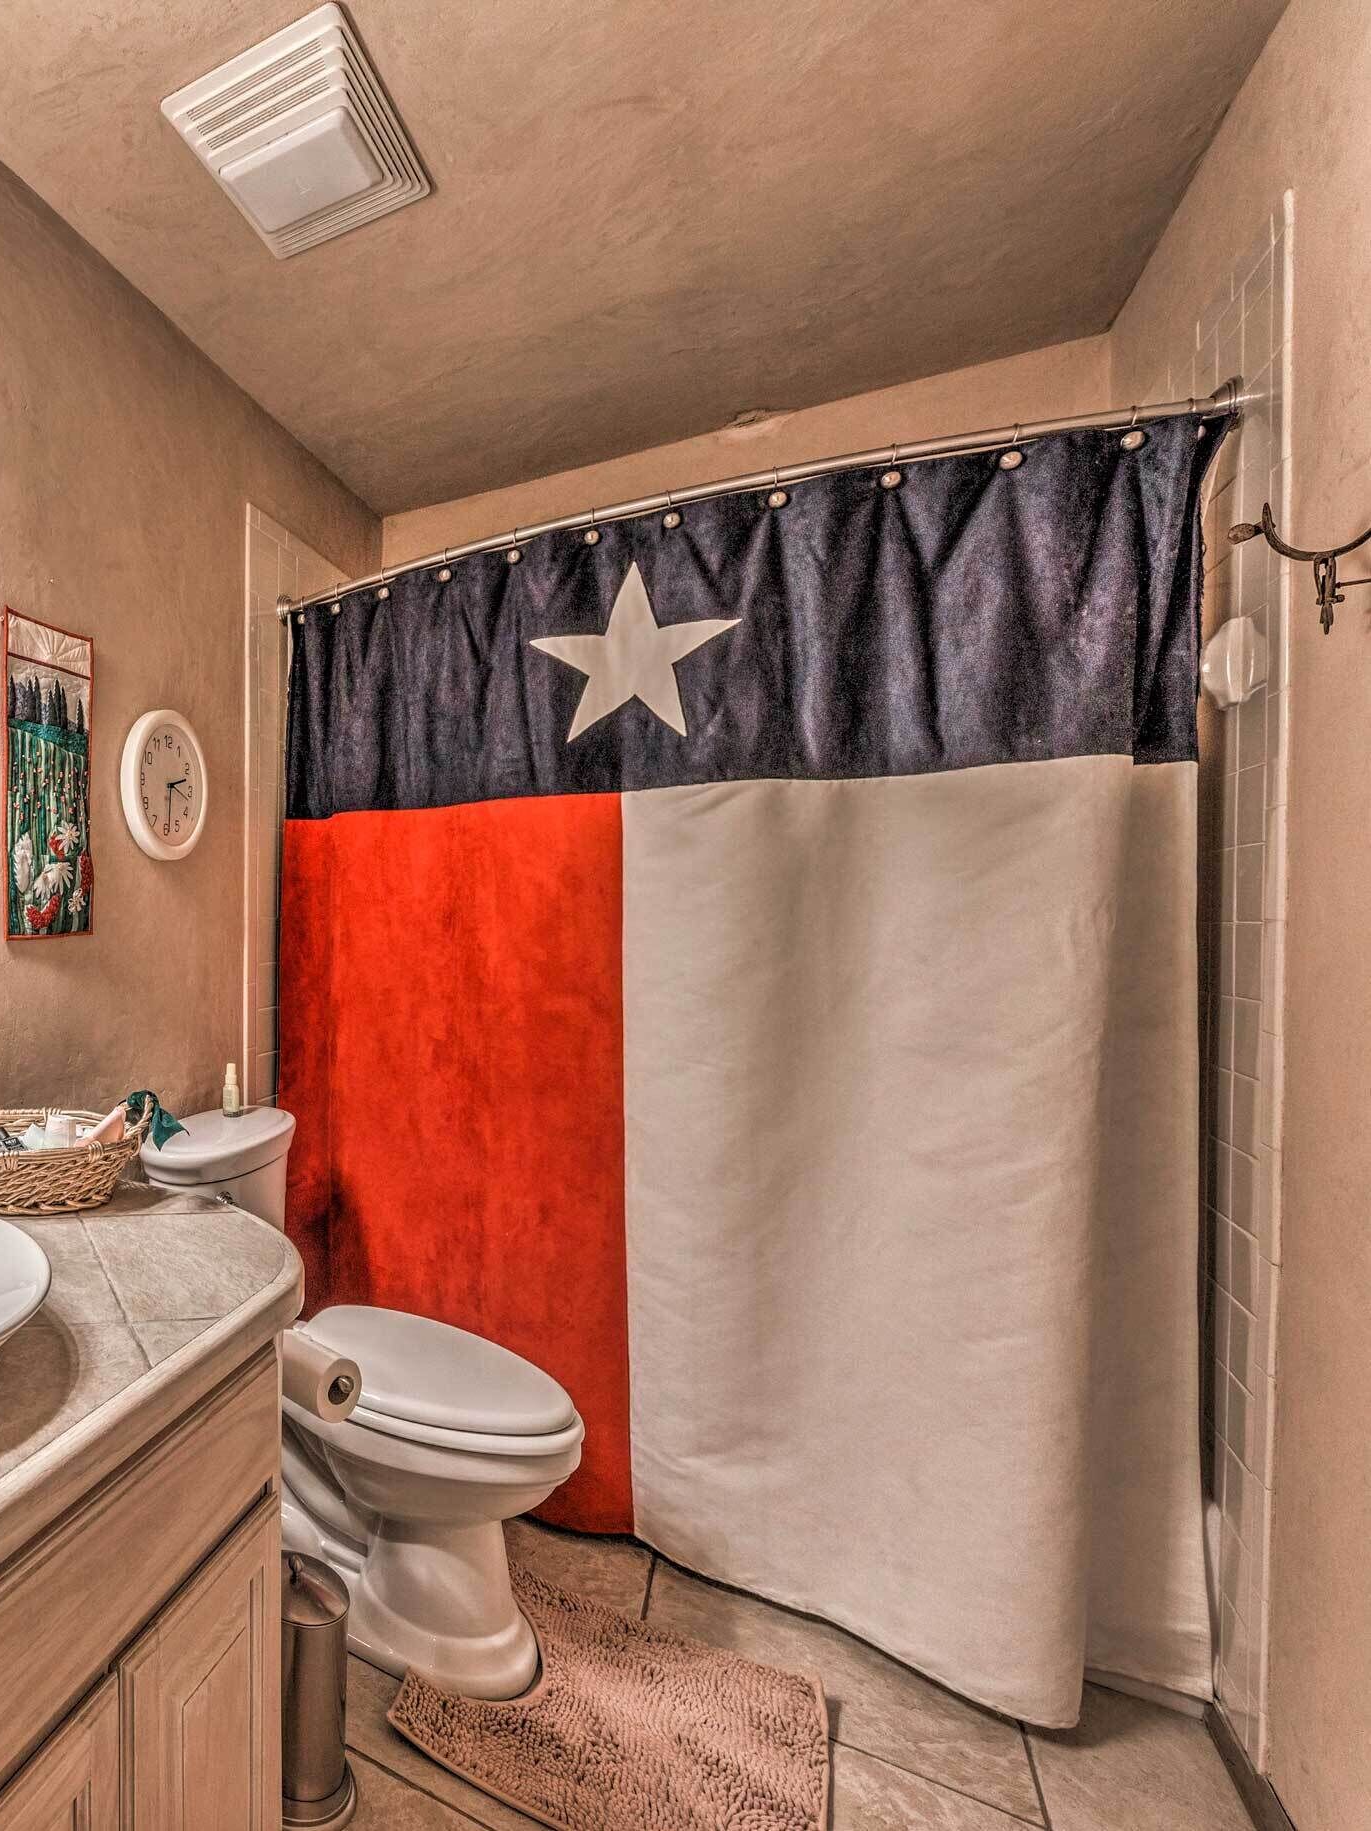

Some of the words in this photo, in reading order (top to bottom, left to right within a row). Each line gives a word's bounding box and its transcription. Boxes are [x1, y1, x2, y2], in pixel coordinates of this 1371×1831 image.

[153, 737, 161, 752] 11
[164, 735, 173, 748] 12
[144, 749, 153, 765] 10
[177, 745, 181, 758] 1
[184, 762, 190, 775] 2
[187, 785, 193, 798] 3
[183, 806, 188, 819] 4
[151, 814, 158, 828] 7
[174, 820, 180, 832] 5
[163, 823, 169, 836] 6
